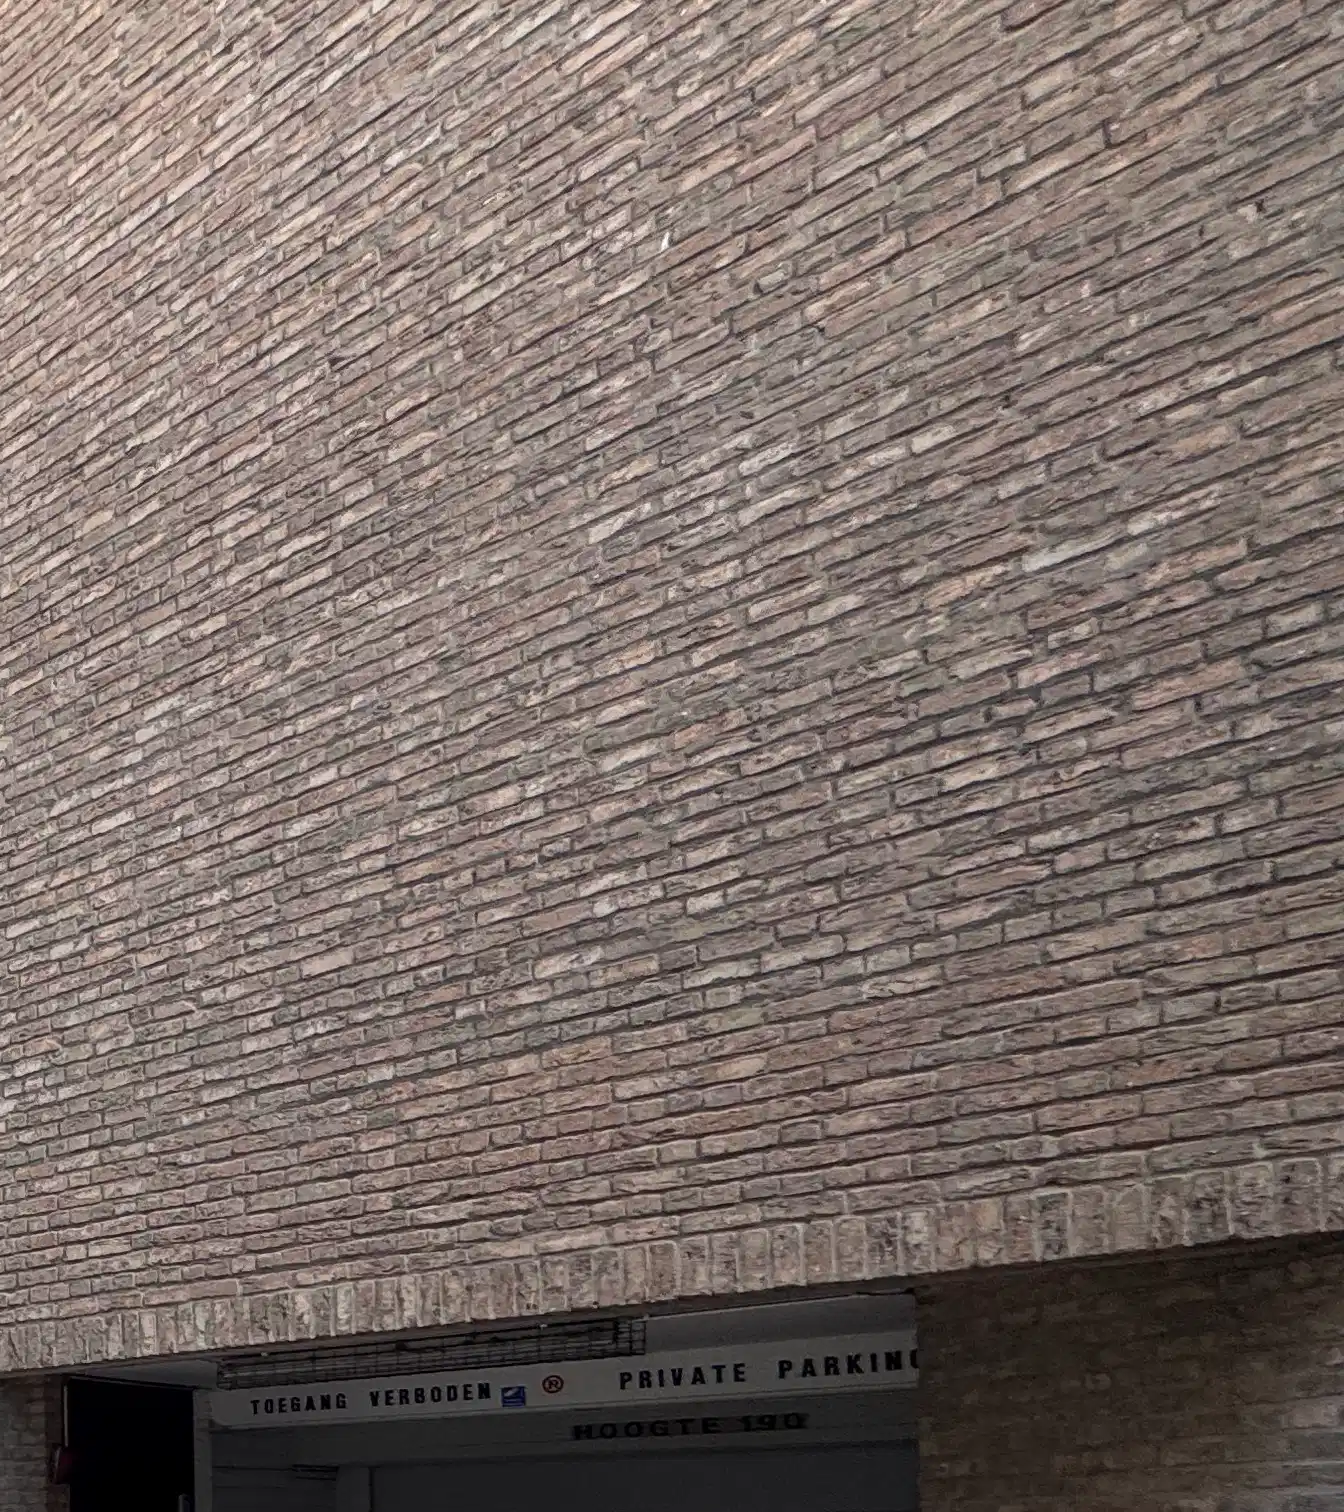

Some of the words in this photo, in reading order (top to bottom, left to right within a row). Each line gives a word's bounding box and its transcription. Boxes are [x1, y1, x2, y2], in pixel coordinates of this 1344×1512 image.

[250, 1392, 348, 1415] TOEGANG
[368, 1382, 492, 1407] VERBODEN
[619, 1362, 746, 1390] PRIVATE
[571, 1417, 724, 1441] HOOGTE
[741, 1412, 808, 1433] 190
